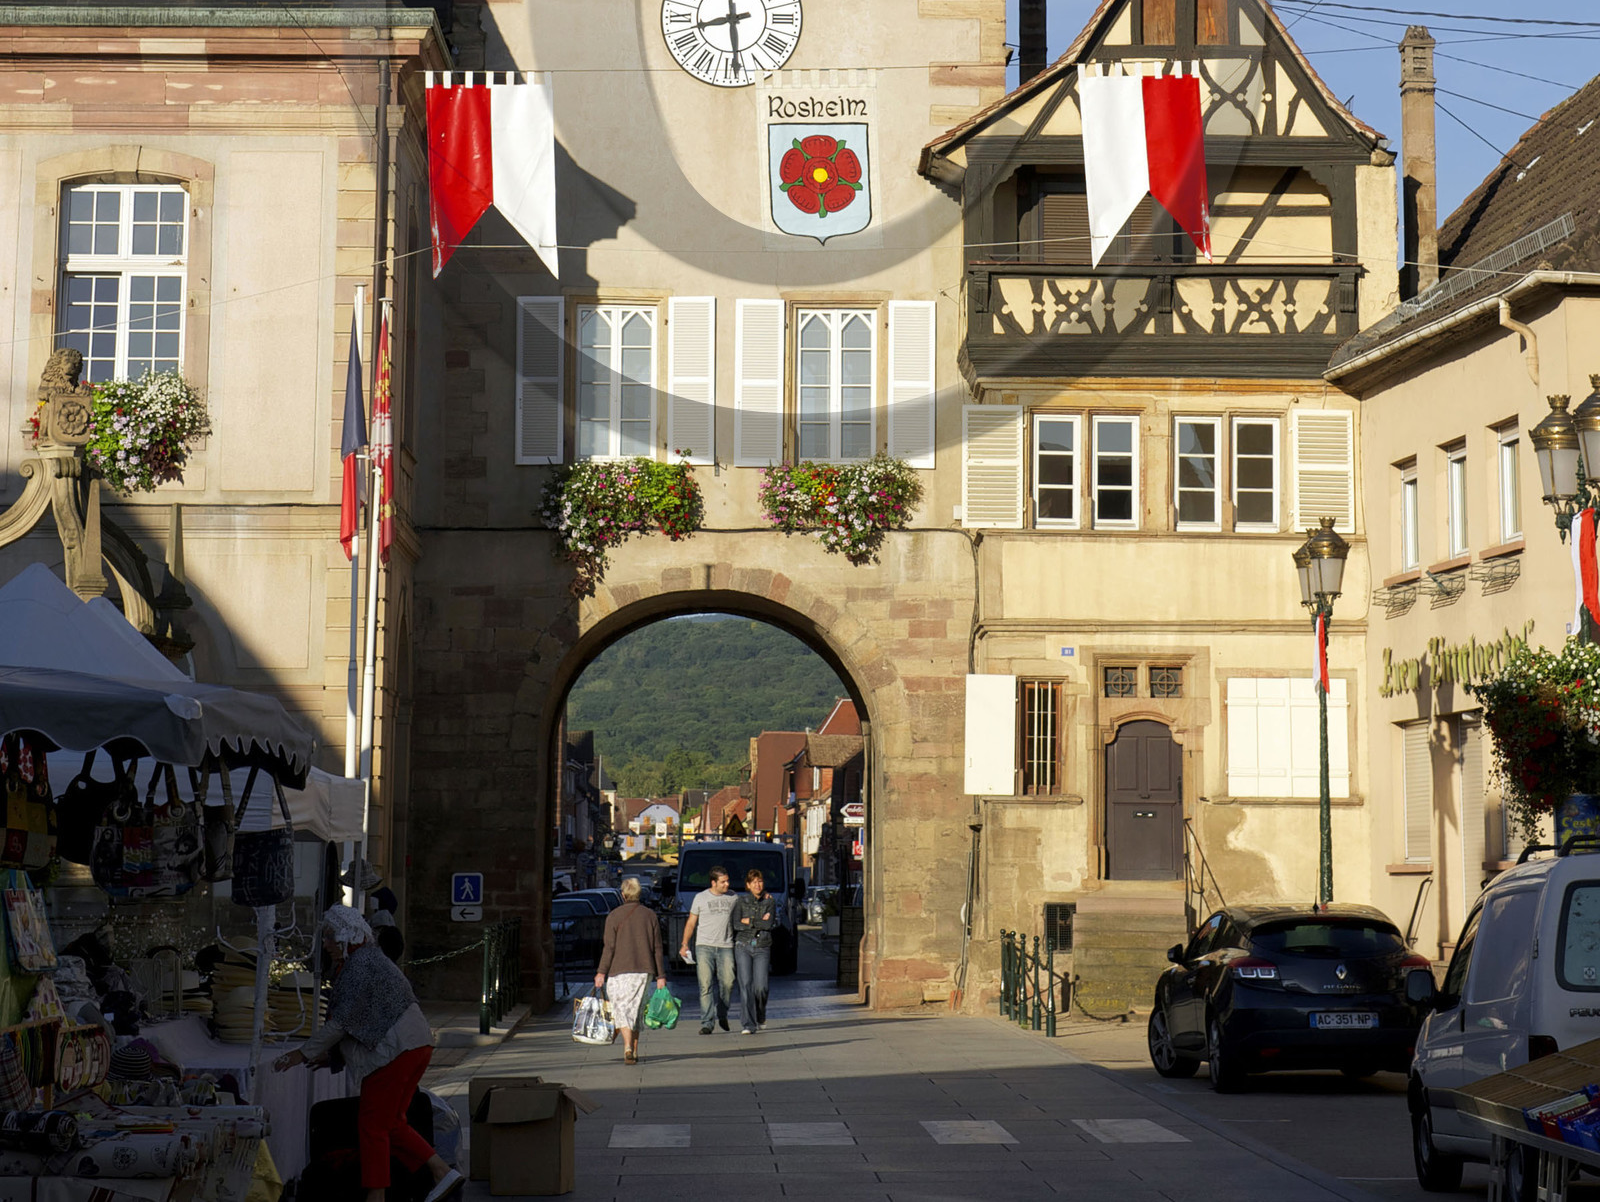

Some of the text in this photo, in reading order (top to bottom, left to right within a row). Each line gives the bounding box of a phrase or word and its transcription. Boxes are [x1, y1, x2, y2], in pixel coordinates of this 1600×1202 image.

[669, 10, 692, 23] IX
[772, 13, 794, 25] III
[674, 31, 701, 58] VIII
[693, 49, 715, 74] VII
[767, 95, 868, 119] Rosheim
[1317, 1014, 1371, 1025] AC-351-NP
